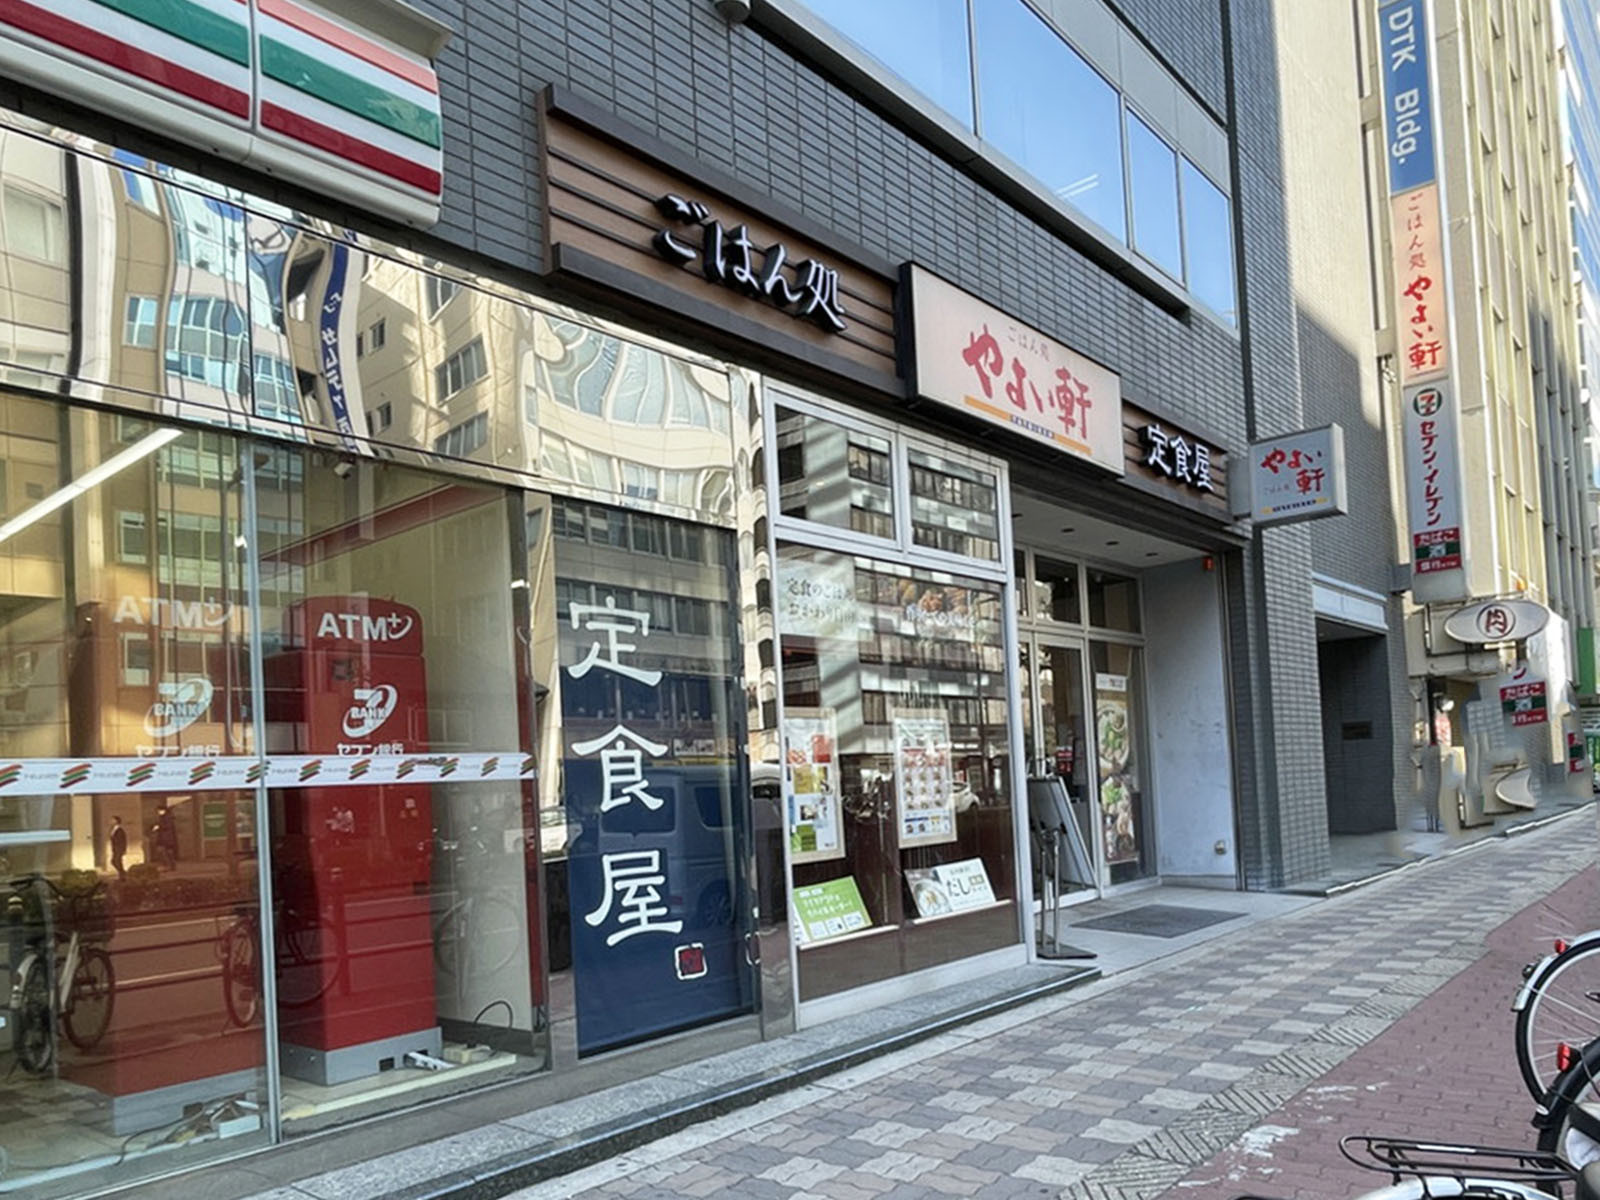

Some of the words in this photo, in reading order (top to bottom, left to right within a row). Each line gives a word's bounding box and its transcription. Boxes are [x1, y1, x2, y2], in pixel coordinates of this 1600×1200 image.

[1388, 6, 1417, 72] DTK
[1392, 87, 1421, 165] Bldg.
[655, 193, 847, 331] ごはん処
[1406, 194, 1427, 271] ごはん処
[1403, 276, 1443, 372] やよい軒
[961, 323, 1092, 440] やよい軒
[1146, 423, 1216, 492] 定食屋
[113, 595, 204, 629] ATM
[317, 612, 389, 642] ATM
[567, 595, 685, 948] 定食屋
